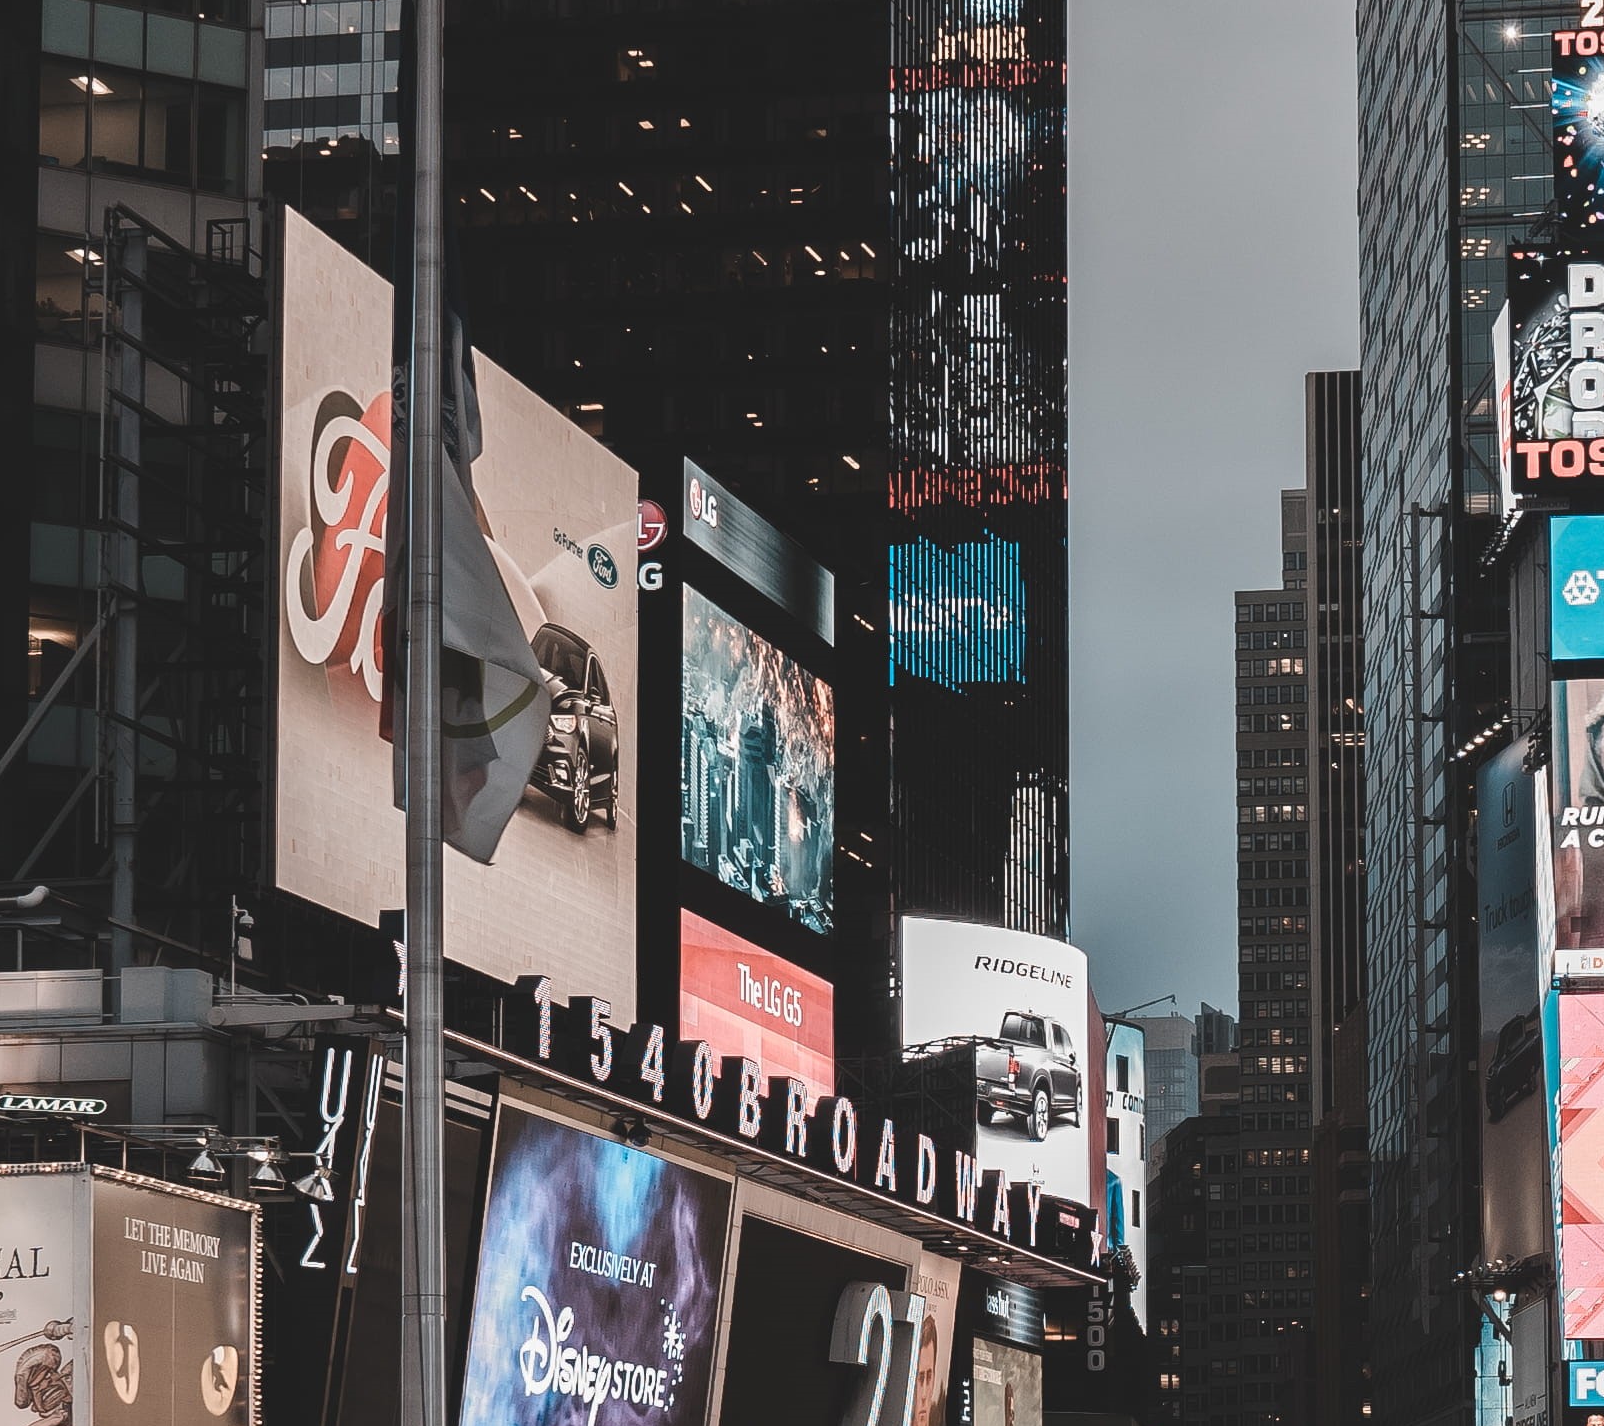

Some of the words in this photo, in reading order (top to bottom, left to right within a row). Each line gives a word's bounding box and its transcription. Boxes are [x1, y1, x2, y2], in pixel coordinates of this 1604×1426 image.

[1560, 829, 1581, 849] A
[974, 953, 1073, 990] RIDGELINE
[737, 962, 760, 1007] The
[762, 976, 783, 1020] LG
[785, 983, 803, 1028] G5
[3, 1097, 97, 1113] LAMAR
[173, 1226, 221, 1259] MEMORY
[169, 1255, 205, 1284] AGAIN
[569, 1240, 633, 1284] EXCLUSIVELY
[612, 1368, 668, 1411] STORE
